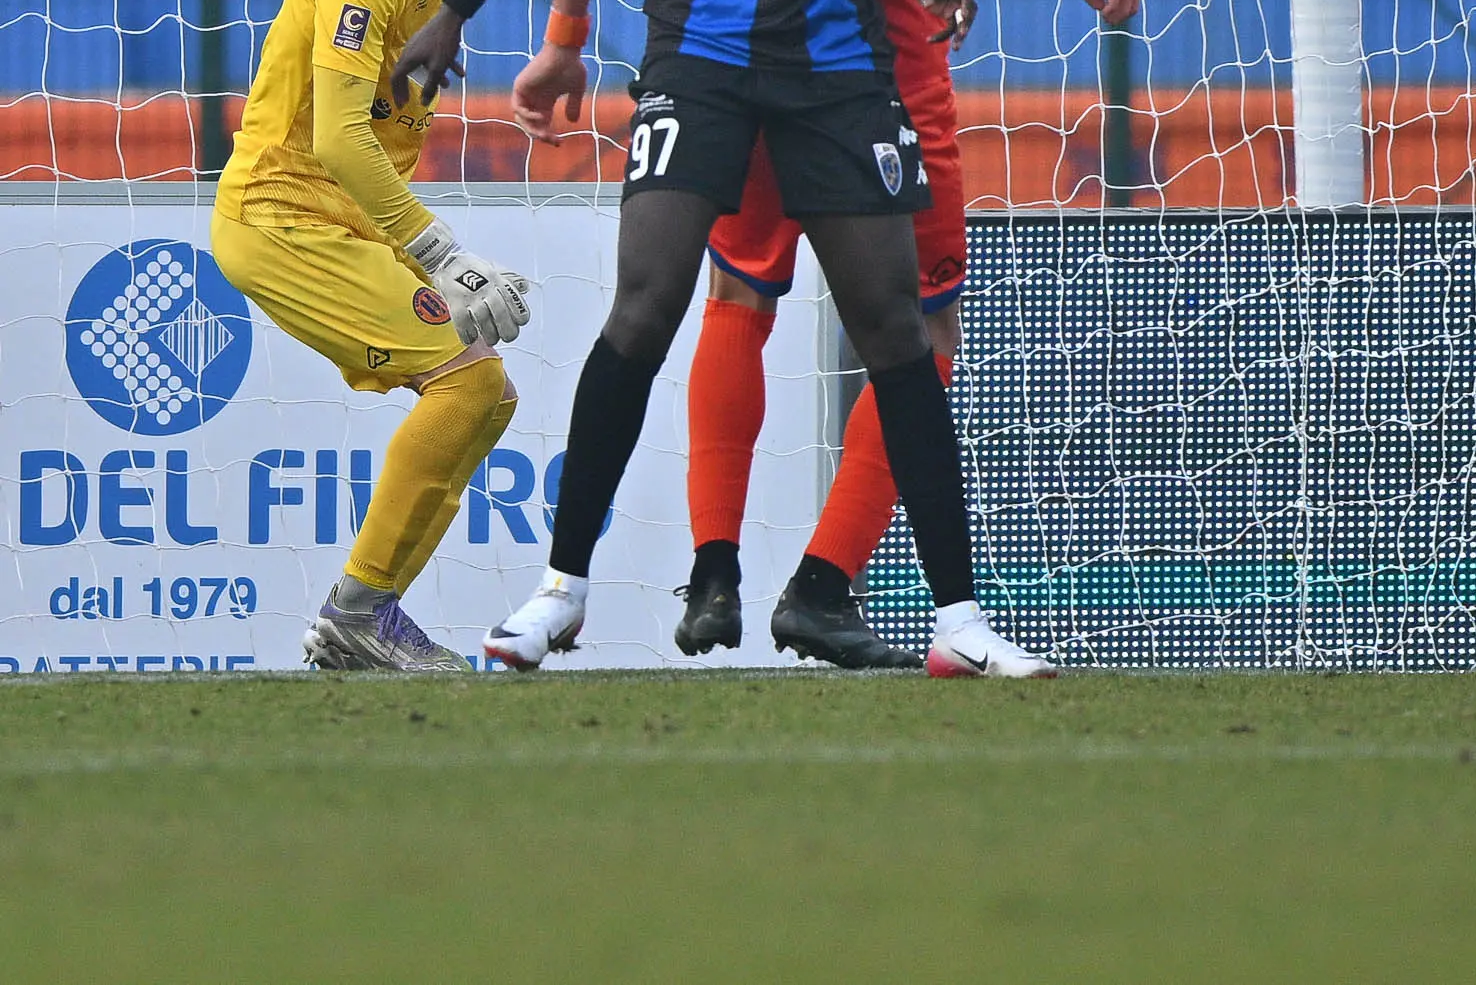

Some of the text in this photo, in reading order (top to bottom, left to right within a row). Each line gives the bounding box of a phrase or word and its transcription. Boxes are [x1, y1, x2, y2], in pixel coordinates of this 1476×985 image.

[343, 8, 365, 31] C
[629, 117, 680, 181] 97
[20, 450, 218, 546] DEL
[50, 577, 257, 620] dal 1979
